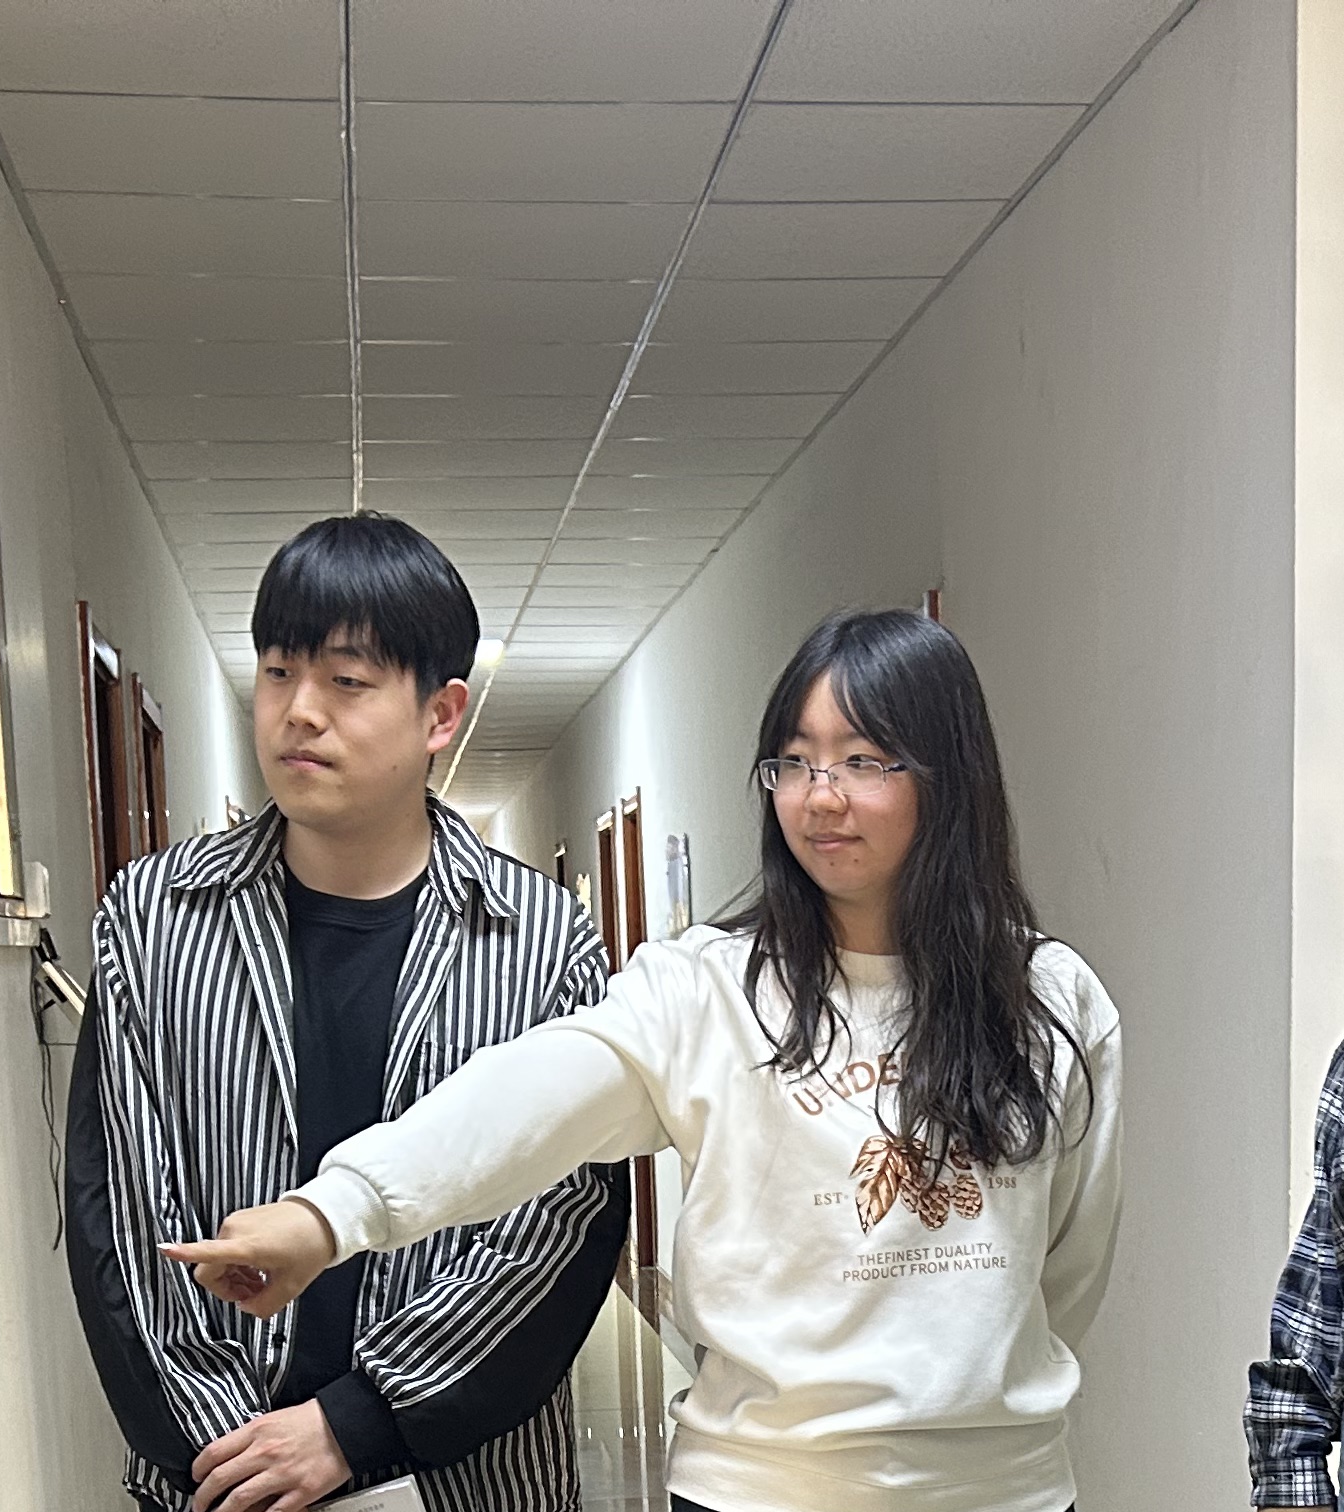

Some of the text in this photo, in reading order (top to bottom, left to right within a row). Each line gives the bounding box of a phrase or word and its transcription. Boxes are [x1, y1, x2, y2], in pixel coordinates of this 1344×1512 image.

[858, 1243, 992, 1266] THEFINEST DUALITY
[843, 1256, 1007, 1282] PRODUCT FROM NATURE
